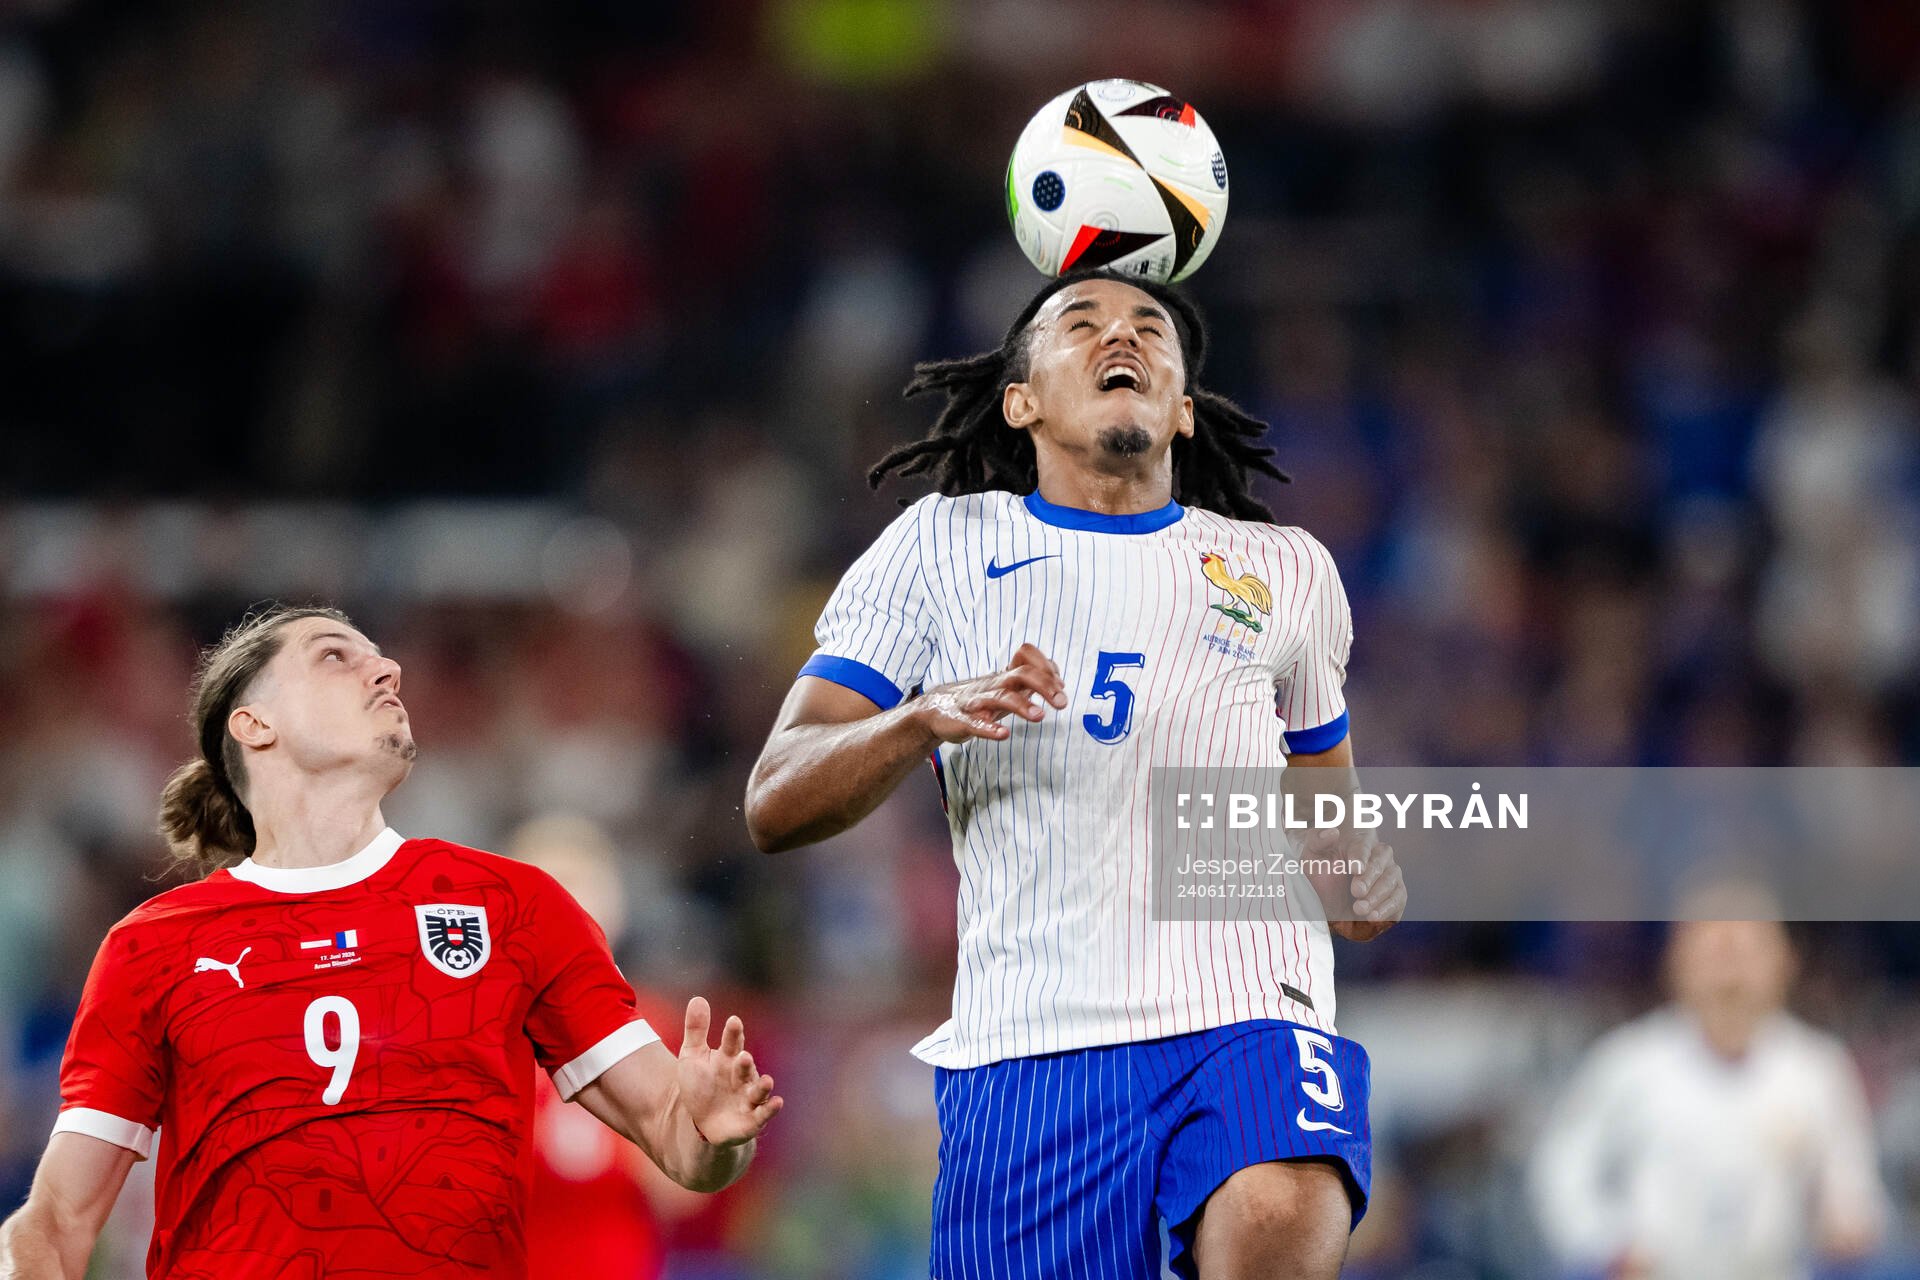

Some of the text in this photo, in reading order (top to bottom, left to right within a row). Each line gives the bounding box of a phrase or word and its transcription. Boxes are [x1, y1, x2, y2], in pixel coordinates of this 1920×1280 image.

[1083, 651, 1145, 745] 5
[303, 995, 361, 1106] 9
[1293, 1028, 1344, 1112] 5
